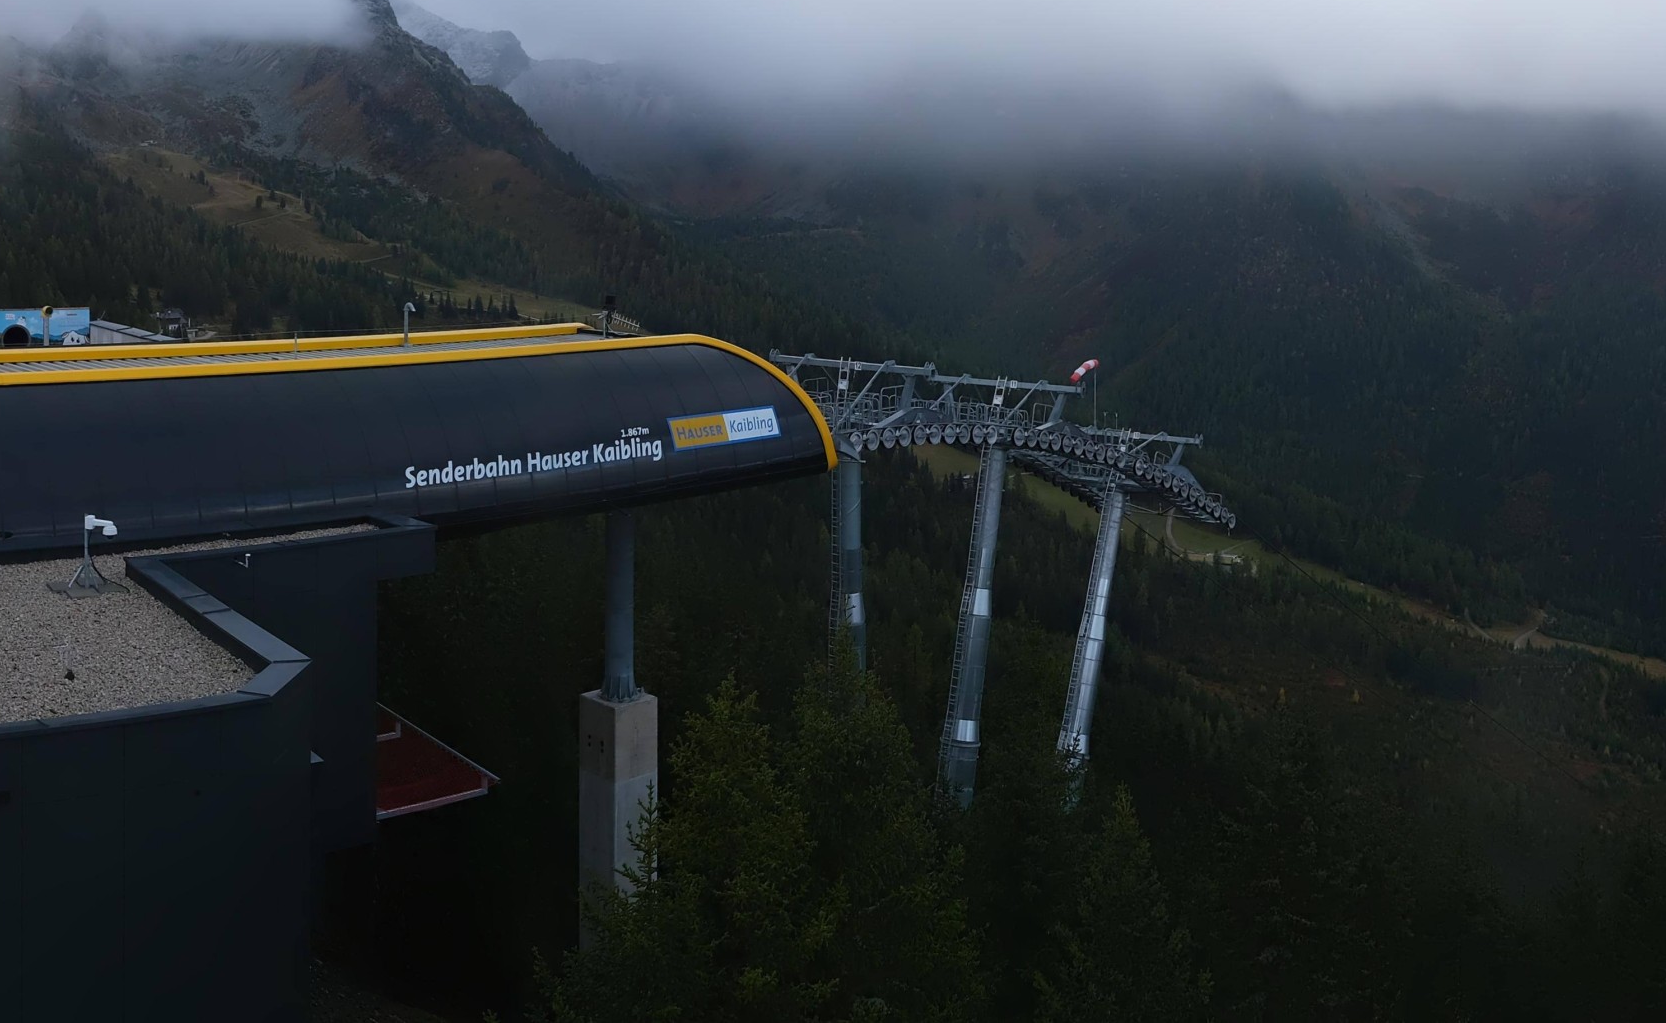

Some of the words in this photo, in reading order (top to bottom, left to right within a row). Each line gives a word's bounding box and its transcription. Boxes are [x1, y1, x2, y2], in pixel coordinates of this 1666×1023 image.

[620, 427, 649, 438] 1.867m
[676, 424, 724, 440] HAUSER
[729, 417, 774, 433] Kaibling
[405, 455, 522, 488] Senderbahn
[527, 449, 588, 473] Hauser
[593, 437, 662, 462] Kaibling
